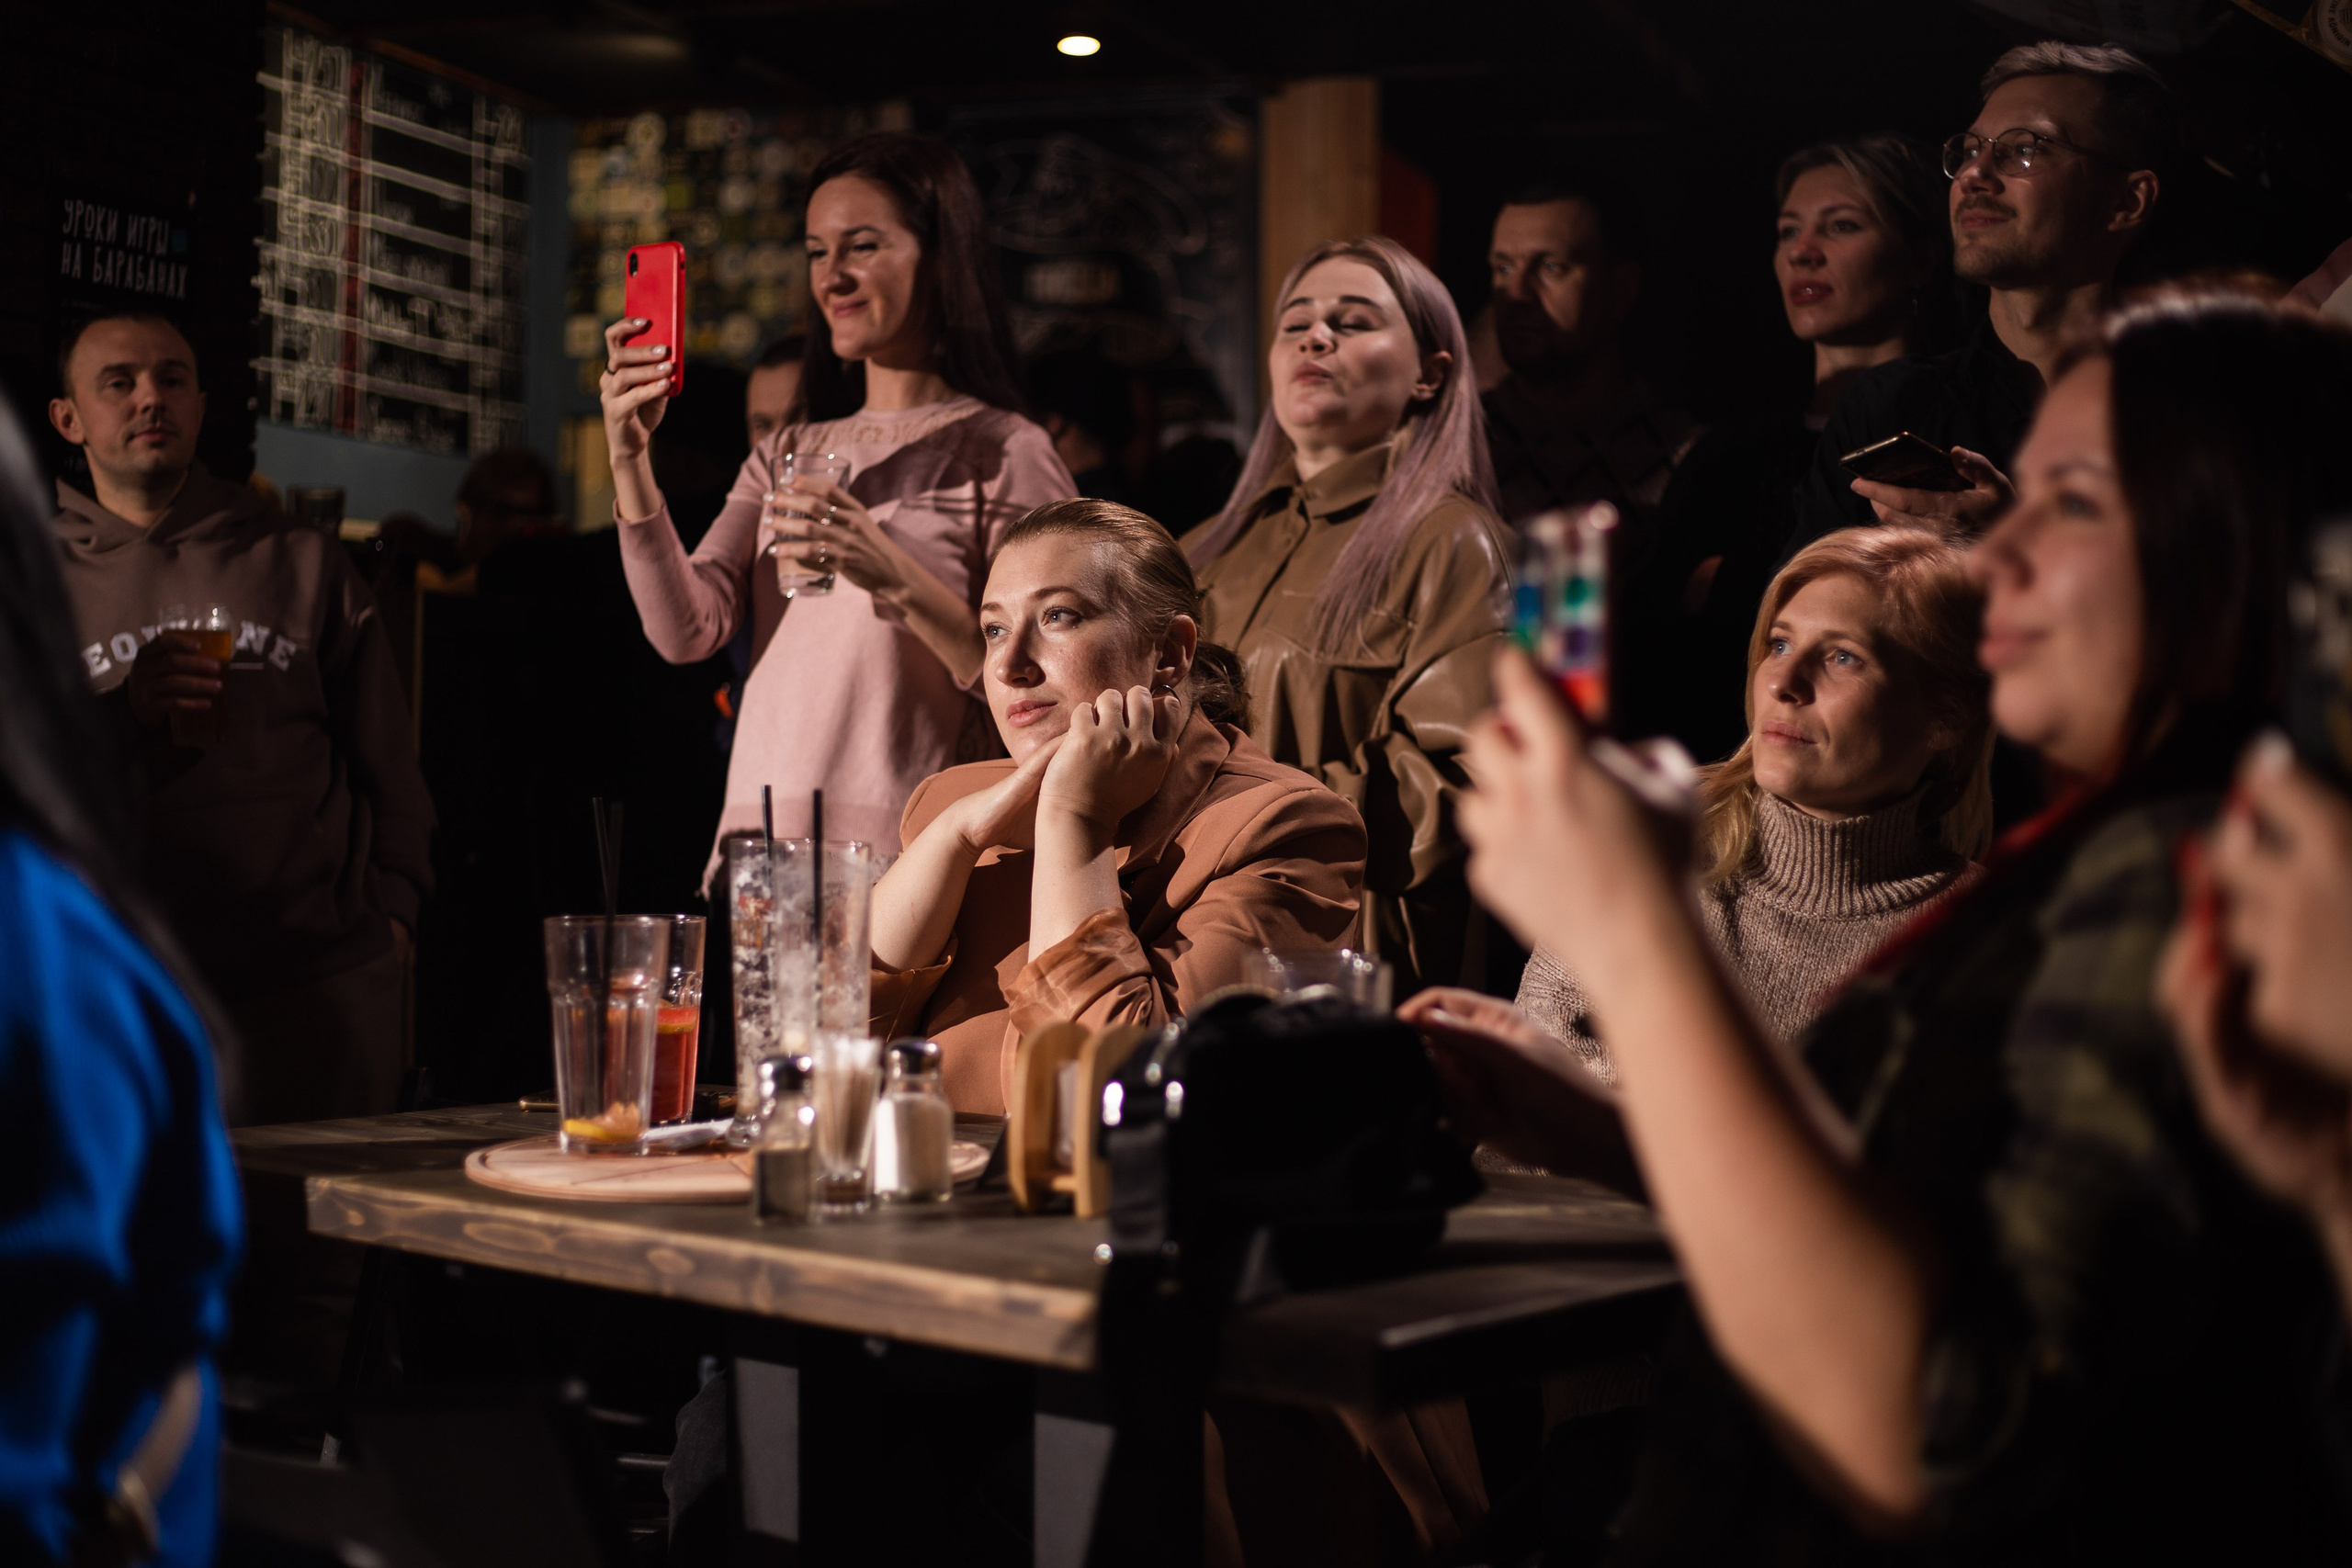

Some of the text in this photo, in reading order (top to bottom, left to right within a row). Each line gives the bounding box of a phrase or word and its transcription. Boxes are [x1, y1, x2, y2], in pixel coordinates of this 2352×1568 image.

[62, 198, 170, 257] УРОКИ ИГРЫ
[61, 241, 189, 301] НА БАРАБАНАХ
